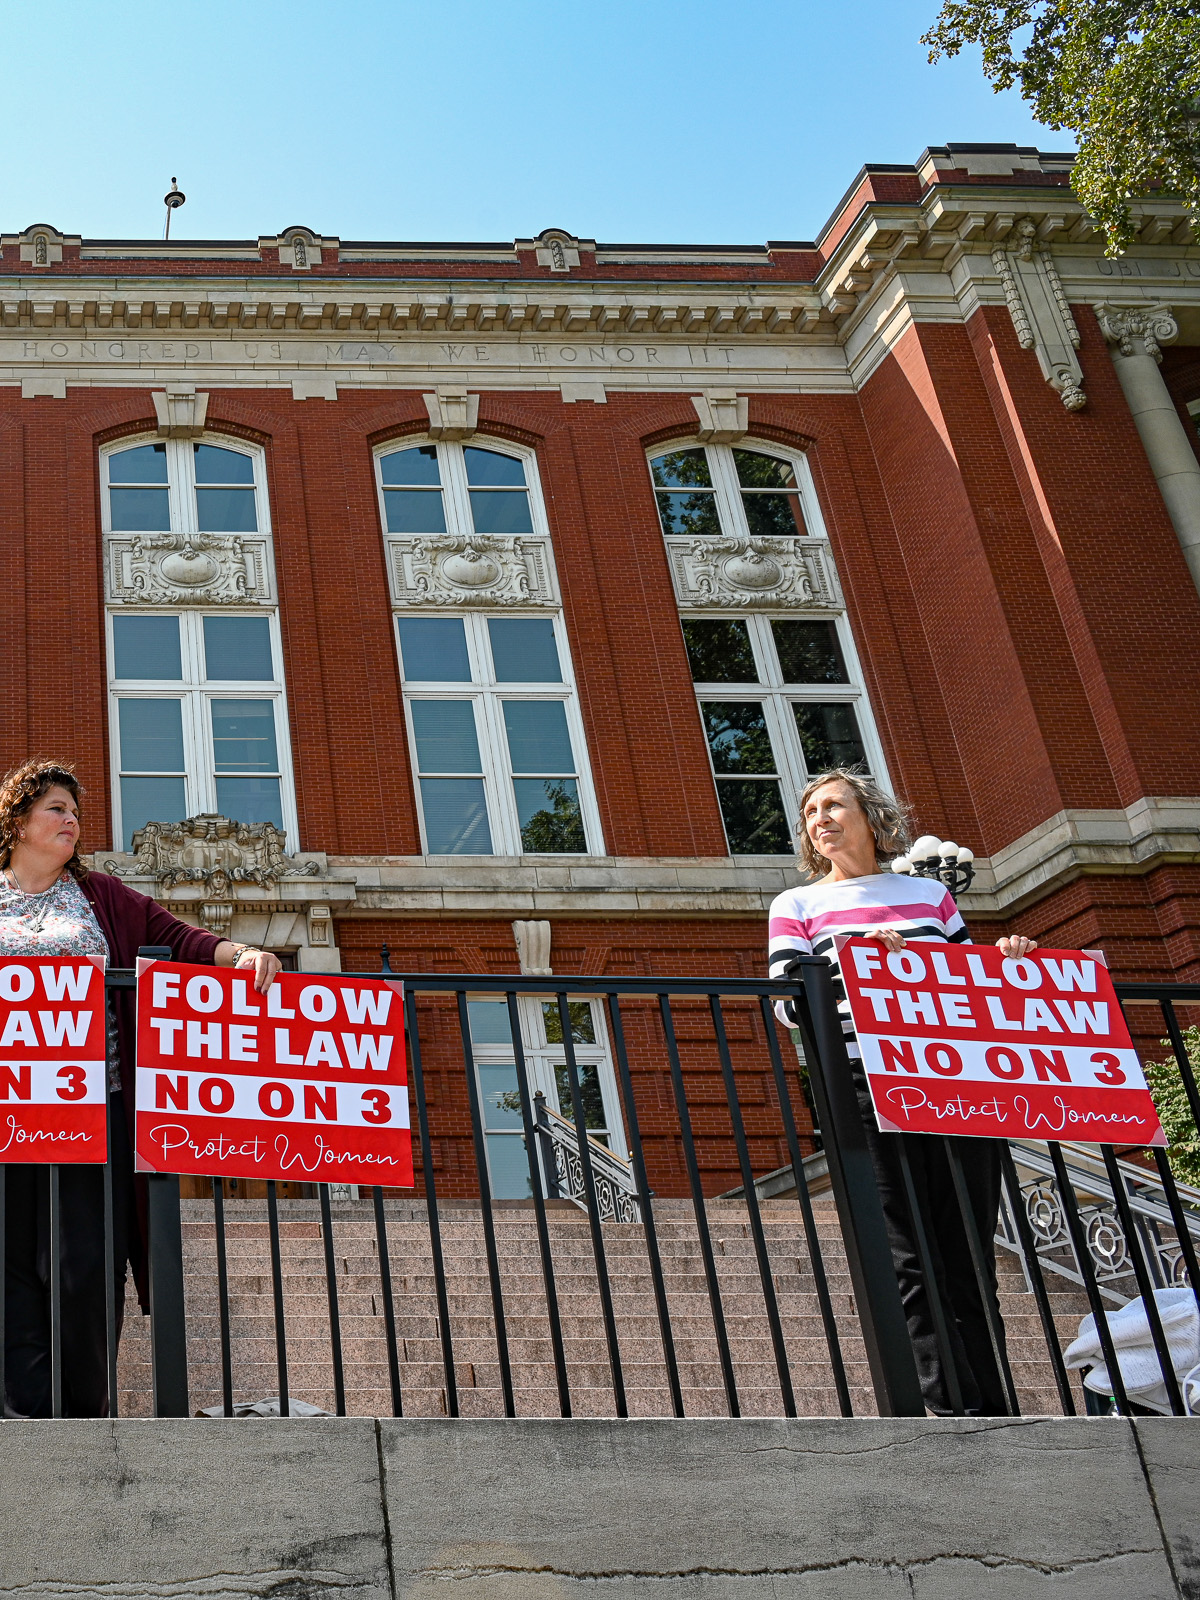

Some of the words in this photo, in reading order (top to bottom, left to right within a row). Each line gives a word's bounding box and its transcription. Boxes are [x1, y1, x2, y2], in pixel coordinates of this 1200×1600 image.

[1095, 260, 1142, 276] UBI
[23, 342, 200, 359] HONORED
[244, 343, 282, 360] US
[325, 343, 396, 361] MAY
[439, 345, 491, 362] WE
[532, 346, 661, 364] HONOR
[701, 347, 735, 364] IT
[850, 945, 1097, 993] FOLLOW
[152, 971, 393, 1026] FOLLOW
[858, 987, 977, 1028] THE
[984, 995, 1110, 1035] LAW
[149, 1016, 259, 1062] THE
[274, 1027, 394, 1071] LAW
[877, 1038, 963, 1077] NO
[984, 1046, 1072, 1083] ON
[1089, 1051, 1126, 1086] 3
[55, 1065, 88, 1101] 3
[155, 1073, 235, 1114] NO
[257, 1081, 338, 1121] ON
[360, 1088, 392, 1124] 3
[886, 1086, 1006, 1122] Protect
[1013, 1094, 1146, 1131] Women
[149, 1124, 267, 1163] Protect
[274, 1133, 399, 1172] Women
